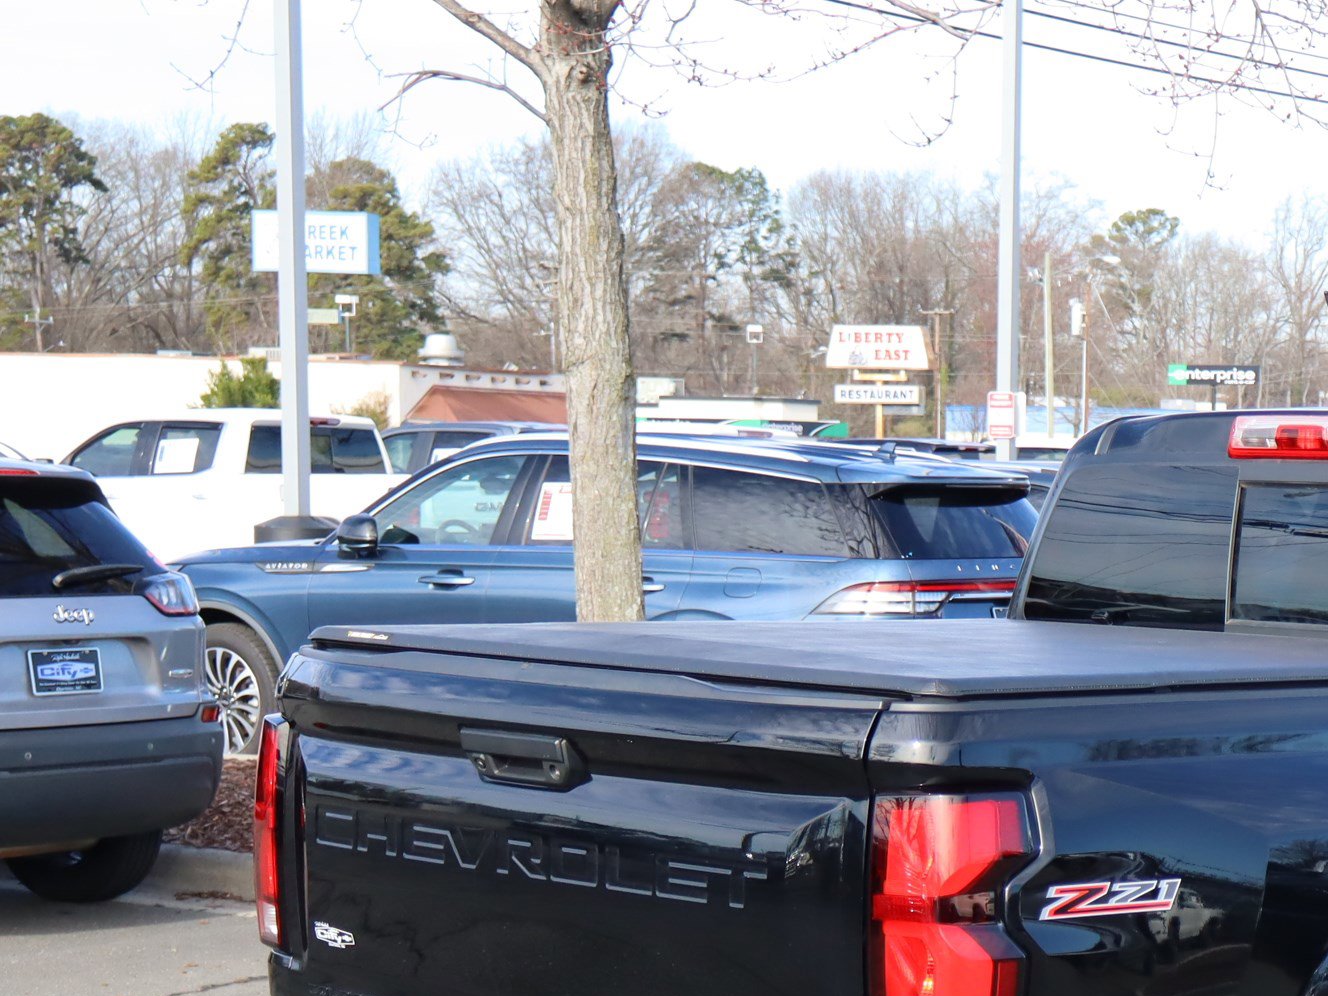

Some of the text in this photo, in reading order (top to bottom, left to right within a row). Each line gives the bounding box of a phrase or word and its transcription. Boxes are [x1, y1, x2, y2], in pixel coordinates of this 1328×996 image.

[307, 225, 349, 240] REEK
[304, 245, 358, 261] ARKET
[838, 331, 904, 343] LIBERTY
[874, 349, 911, 361] EAST
[1173, 367, 1256, 383] enterprise
[840, 389, 914, 400] RESTAURANT
[474, 502, 502, 512] GM
[53, 604, 95, 625] Jeep
[316, 805, 768, 909] CHEVROLET
[1039, 878, 1182, 921] Z71
